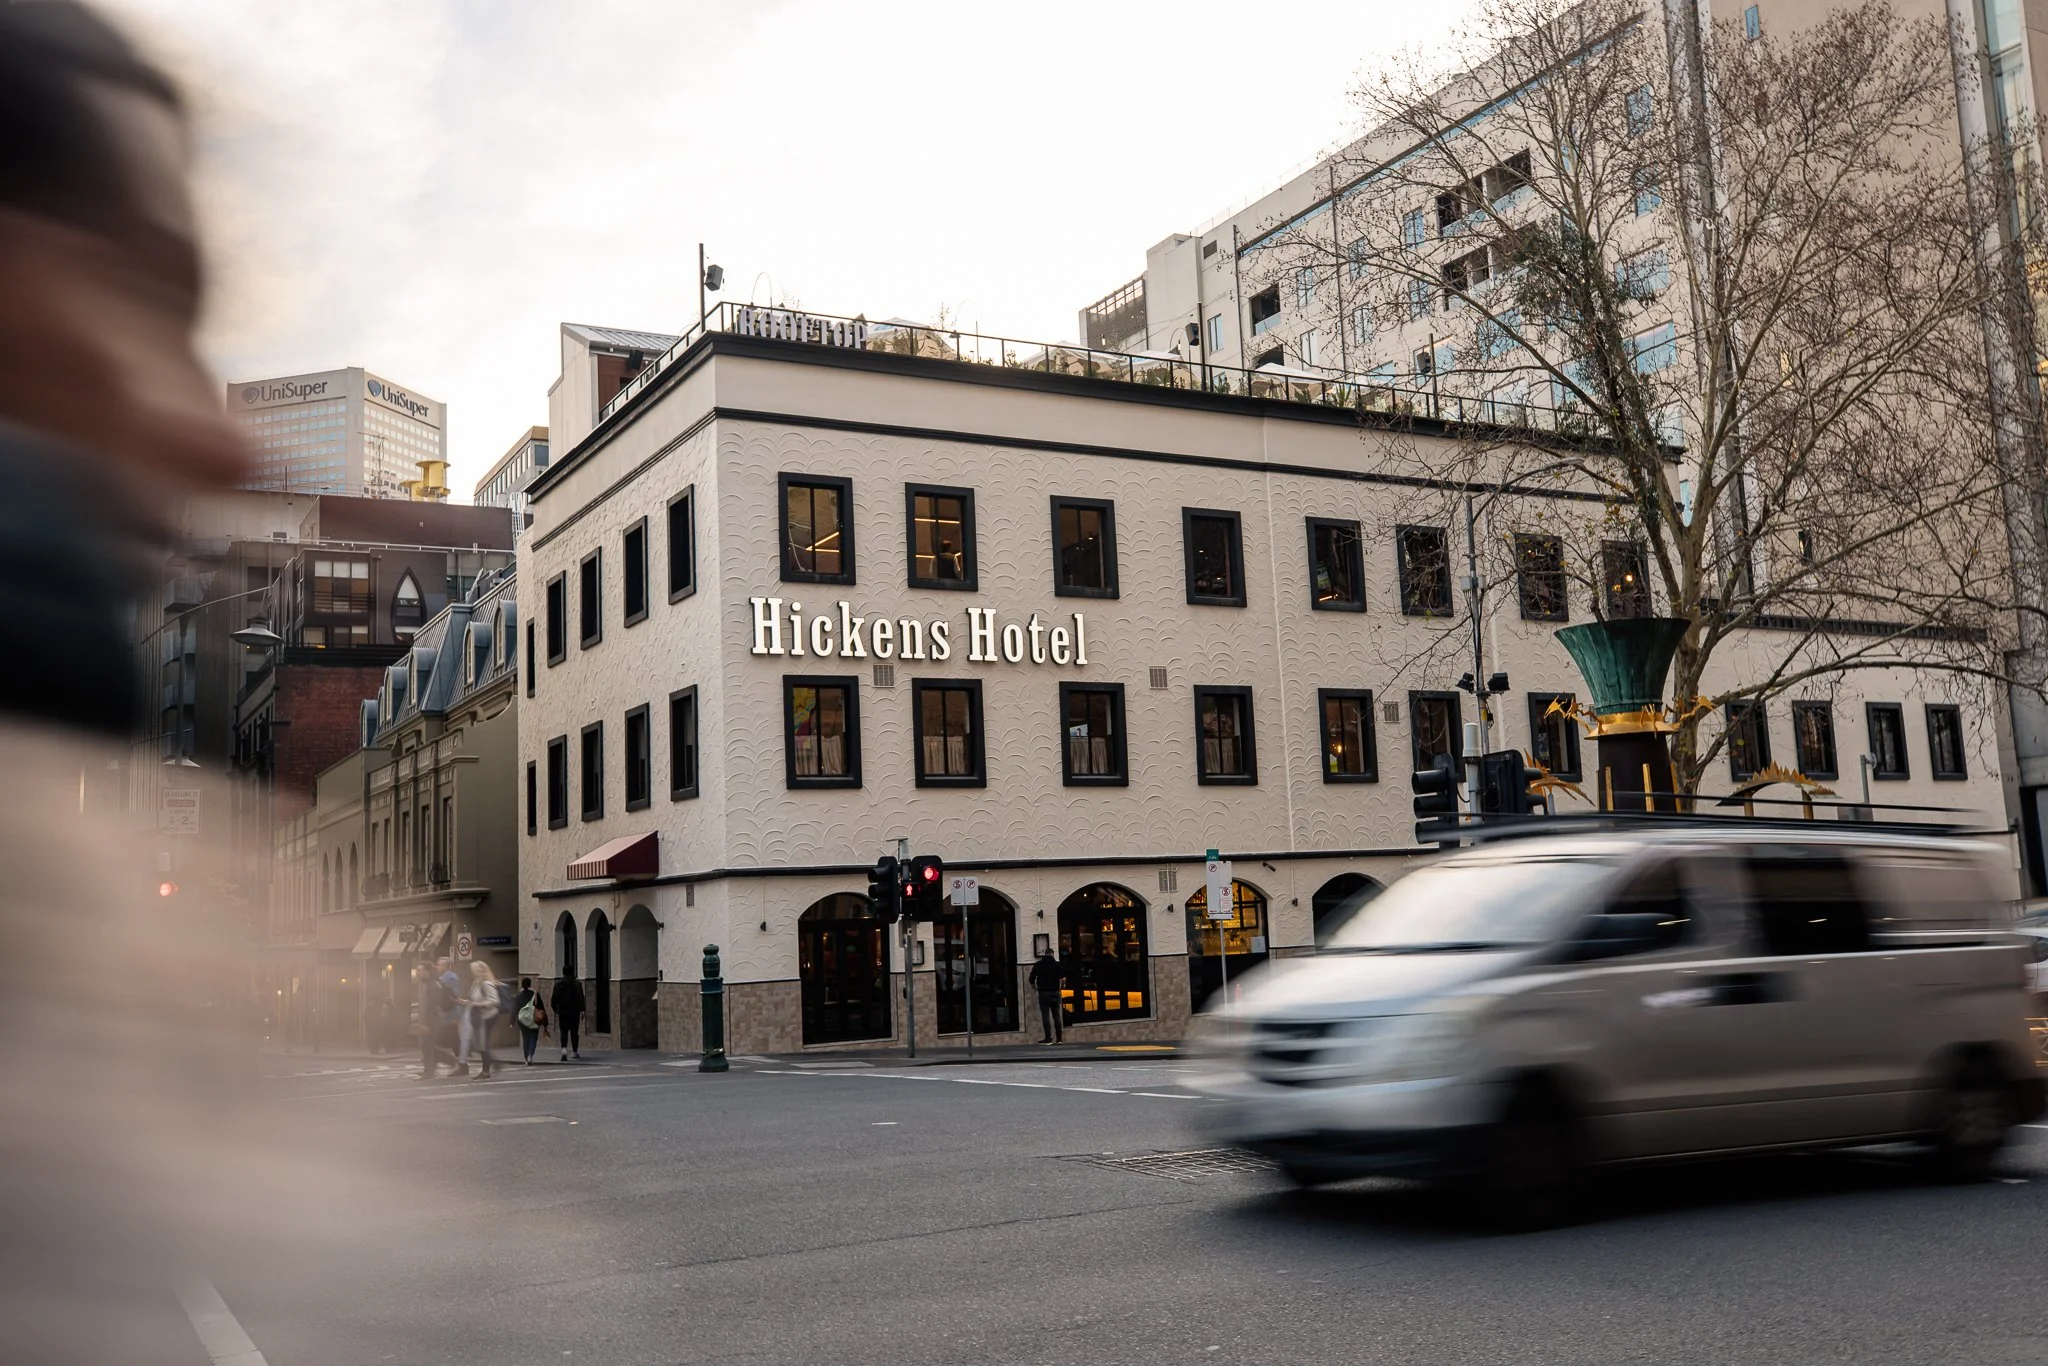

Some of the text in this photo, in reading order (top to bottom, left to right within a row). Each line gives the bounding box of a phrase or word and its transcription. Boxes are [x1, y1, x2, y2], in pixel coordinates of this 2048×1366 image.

[737, 308, 868, 350] ROOFTOP
[261, 380, 328, 401] UniSuper
[381, 383, 430, 417] UniSuper
[750, 597, 1089, 665] Hickens Hotel
[460, 941, 471, 952] 20
